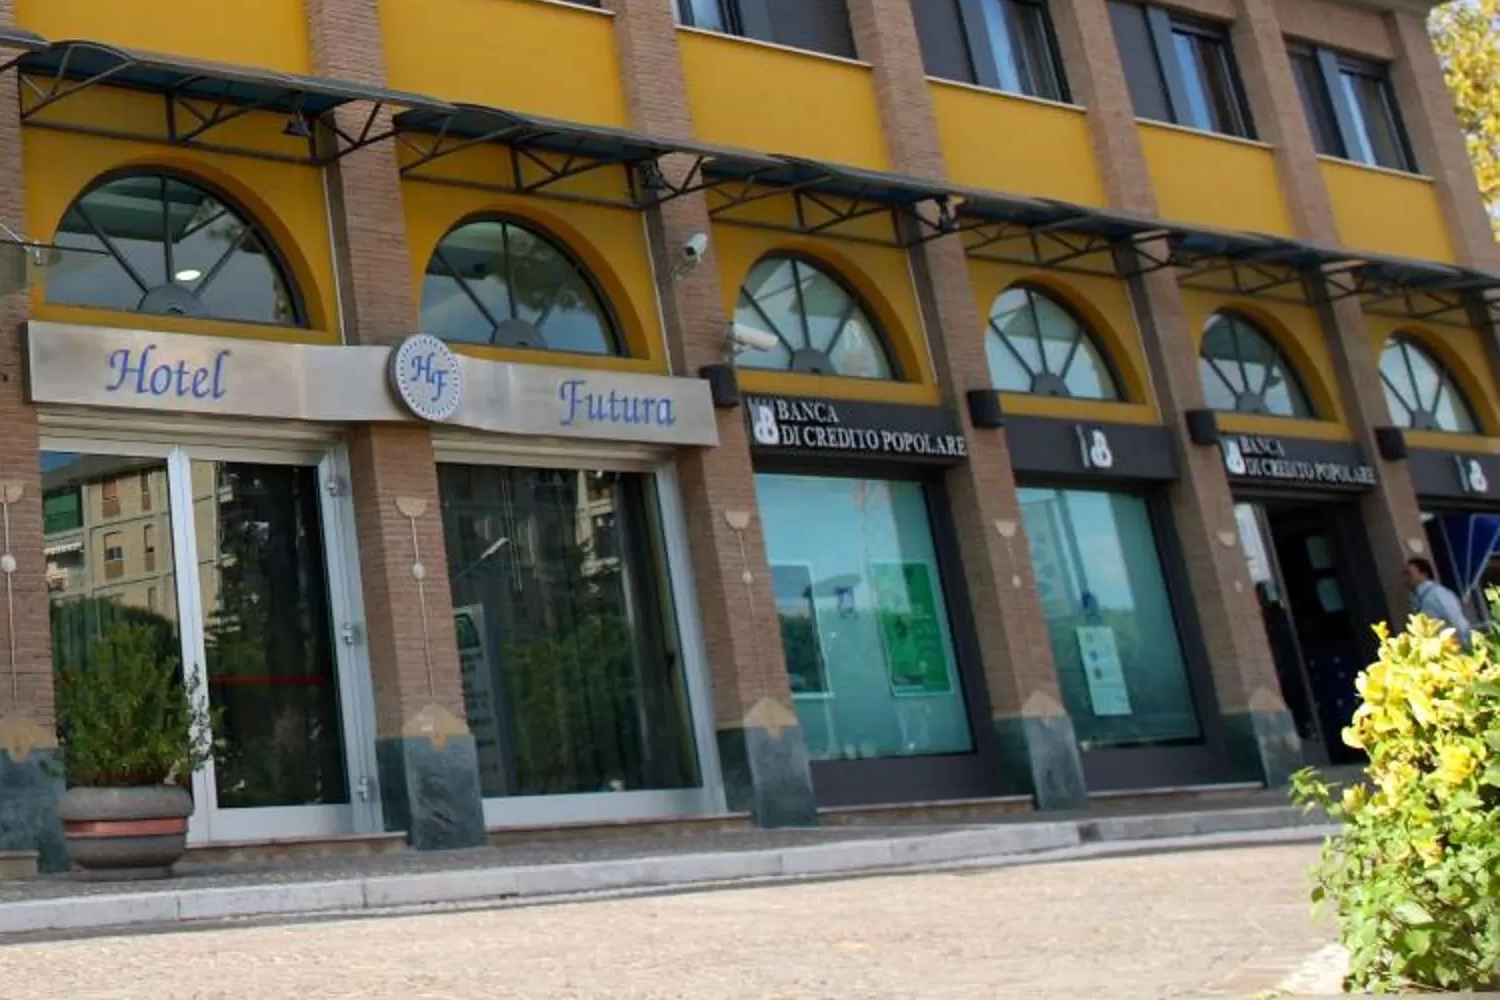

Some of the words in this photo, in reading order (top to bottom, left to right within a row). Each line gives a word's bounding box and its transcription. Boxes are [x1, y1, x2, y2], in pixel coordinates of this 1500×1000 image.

[105, 343, 232, 399] Hotel
[559, 379, 677, 427] Futura
[777, 400, 839, 423] BANCA
[780, 425, 801, 446] DI
[803, 426, 879, 450] CREDITO
[880, 430, 968, 456] POPOLARE
